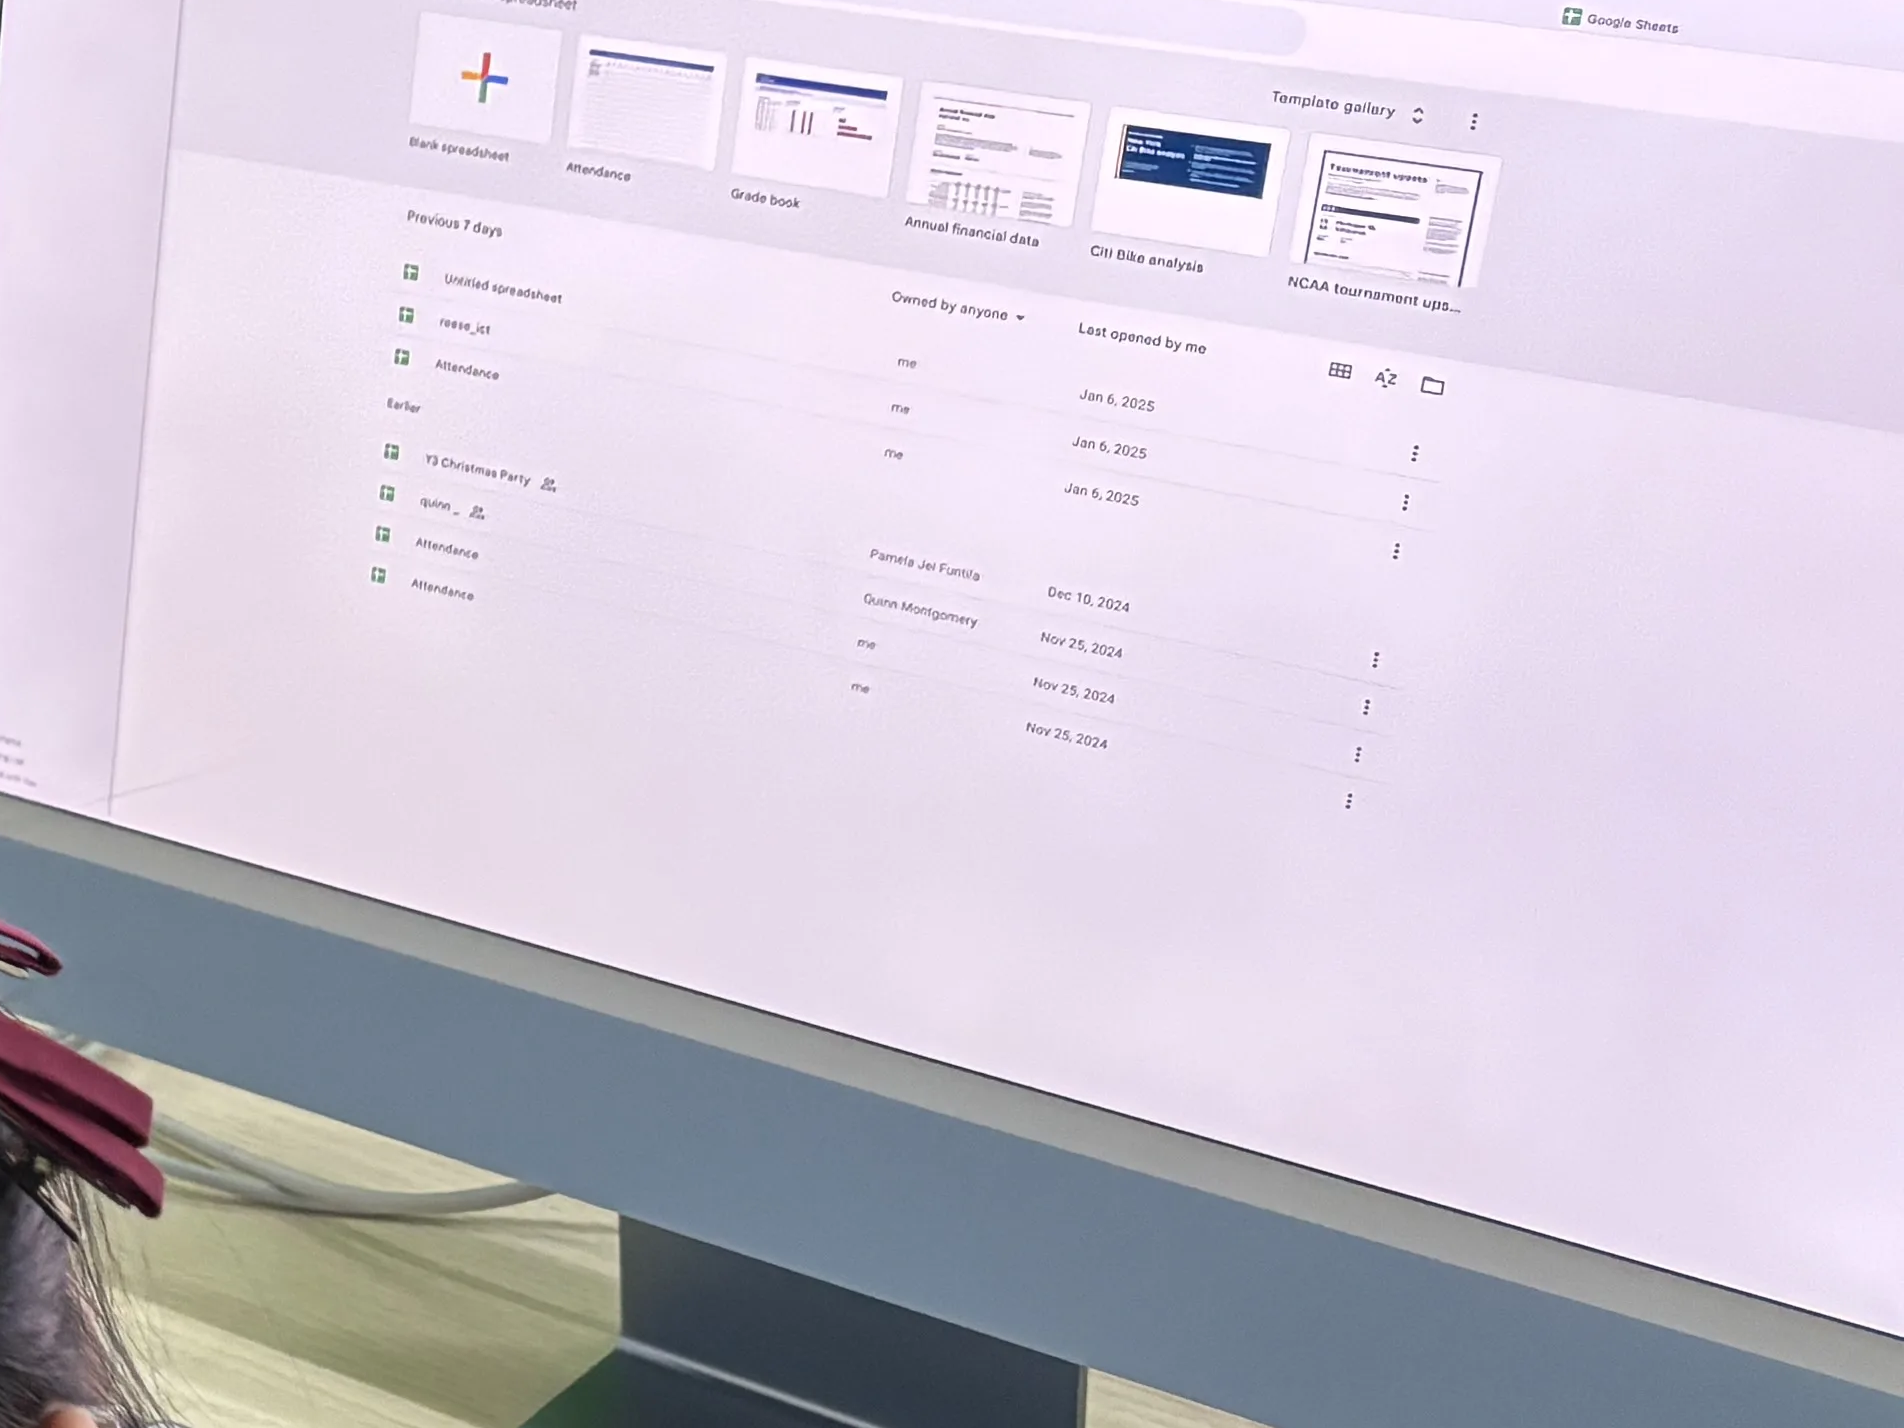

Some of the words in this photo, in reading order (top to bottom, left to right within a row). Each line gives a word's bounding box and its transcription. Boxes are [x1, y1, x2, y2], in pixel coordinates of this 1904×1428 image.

[1587, 13, 1632, 29] Google
[1635, 19, 1679, 34] Sheets
[1272, 90, 1340, 110] Template
[1343, 101, 1396, 120] gallery
[408, 136, 439, 151] Blank
[441, 143, 510, 162] spreadsheet
[566, 162, 632, 182] Attendance
[730, 187, 767, 204] Grade
[769, 194, 801, 209] book
[406, 209, 460, 230] Previous
[463, 219, 471, 231] 7
[472, 221, 503, 239] days
[904, 216, 949, 233] Annual
[952, 222, 1008, 242] financial
[1009, 232, 1040, 248] data
[1090, 244, 1113, 259] Citi
[1116, 248, 1145, 264] Bike
[1148, 256, 1204, 274] analysis
[444, 273, 490, 291] Untitled
[491, 283, 563, 305] spreadsheet
[1287, 276, 1329, 292] NCAA
[1334, 283, 1419, 307] tournament
[891, 290, 938, 309] Owned
[940, 298, 958, 315] by
[960, 303, 1009, 324] anyone
[1078, 321, 1107, 338] Last
[1110, 329, 1162, 350] opened
[1164, 336, 1182, 353] by
[1185, 342, 1207, 355] me
[435, 358, 500, 381] Attendance
[897, 358, 918, 369] me
[386, 397, 421, 414] Earlier
[890, 403, 911, 415] me
[1079, 388, 1104, 403] Jan
[1105, 394, 1119, 410] 6,
[1121, 395, 1156, 413] 2025
[883, 448, 904, 461] me
[1071, 436, 1096, 450] Jan
[1097, 441, 1111, 457] 6,
[1113, 443, 1148, 460] 2025
[440, 457, 498, 479] Christmas
[499, 469, 532, 488] Party
[1064, 482, 1088, 496] Jan
[1090, 487, 1104, 504] 6,
[1105, 489, 1140, 507] 2025
[415, 537, 479, 561] Attendance
[869, 548, 915, 568] Pamela
[410, 578, 475, 602] Attendance
[1047, 585, 1072, 601] Dec
[1076, 590, 1094, 608] 10,
[1097, 596, 1130, 613] 2024
[863, 592, 898, 610] Quinn
[900, 601, 979, 630] Montgomery
[856, 639, 877, 650] me
[1040, 631, 1067, 647] Nov
[1068, 637, 1088, 654] 25,
[1090, 642, 1123, 659] 2024
[850, 683, 870, 694] me
[1032, 676, 1059, 691] Nov
[1060, 682, 1081, 699] 25,
[1083, 687, 1115, 705] 2024
[1025, 721, 1052, 737] Nov
[1053, 727, 1073, 744] 25,
[1075, 732, 1108, 750] 2024
